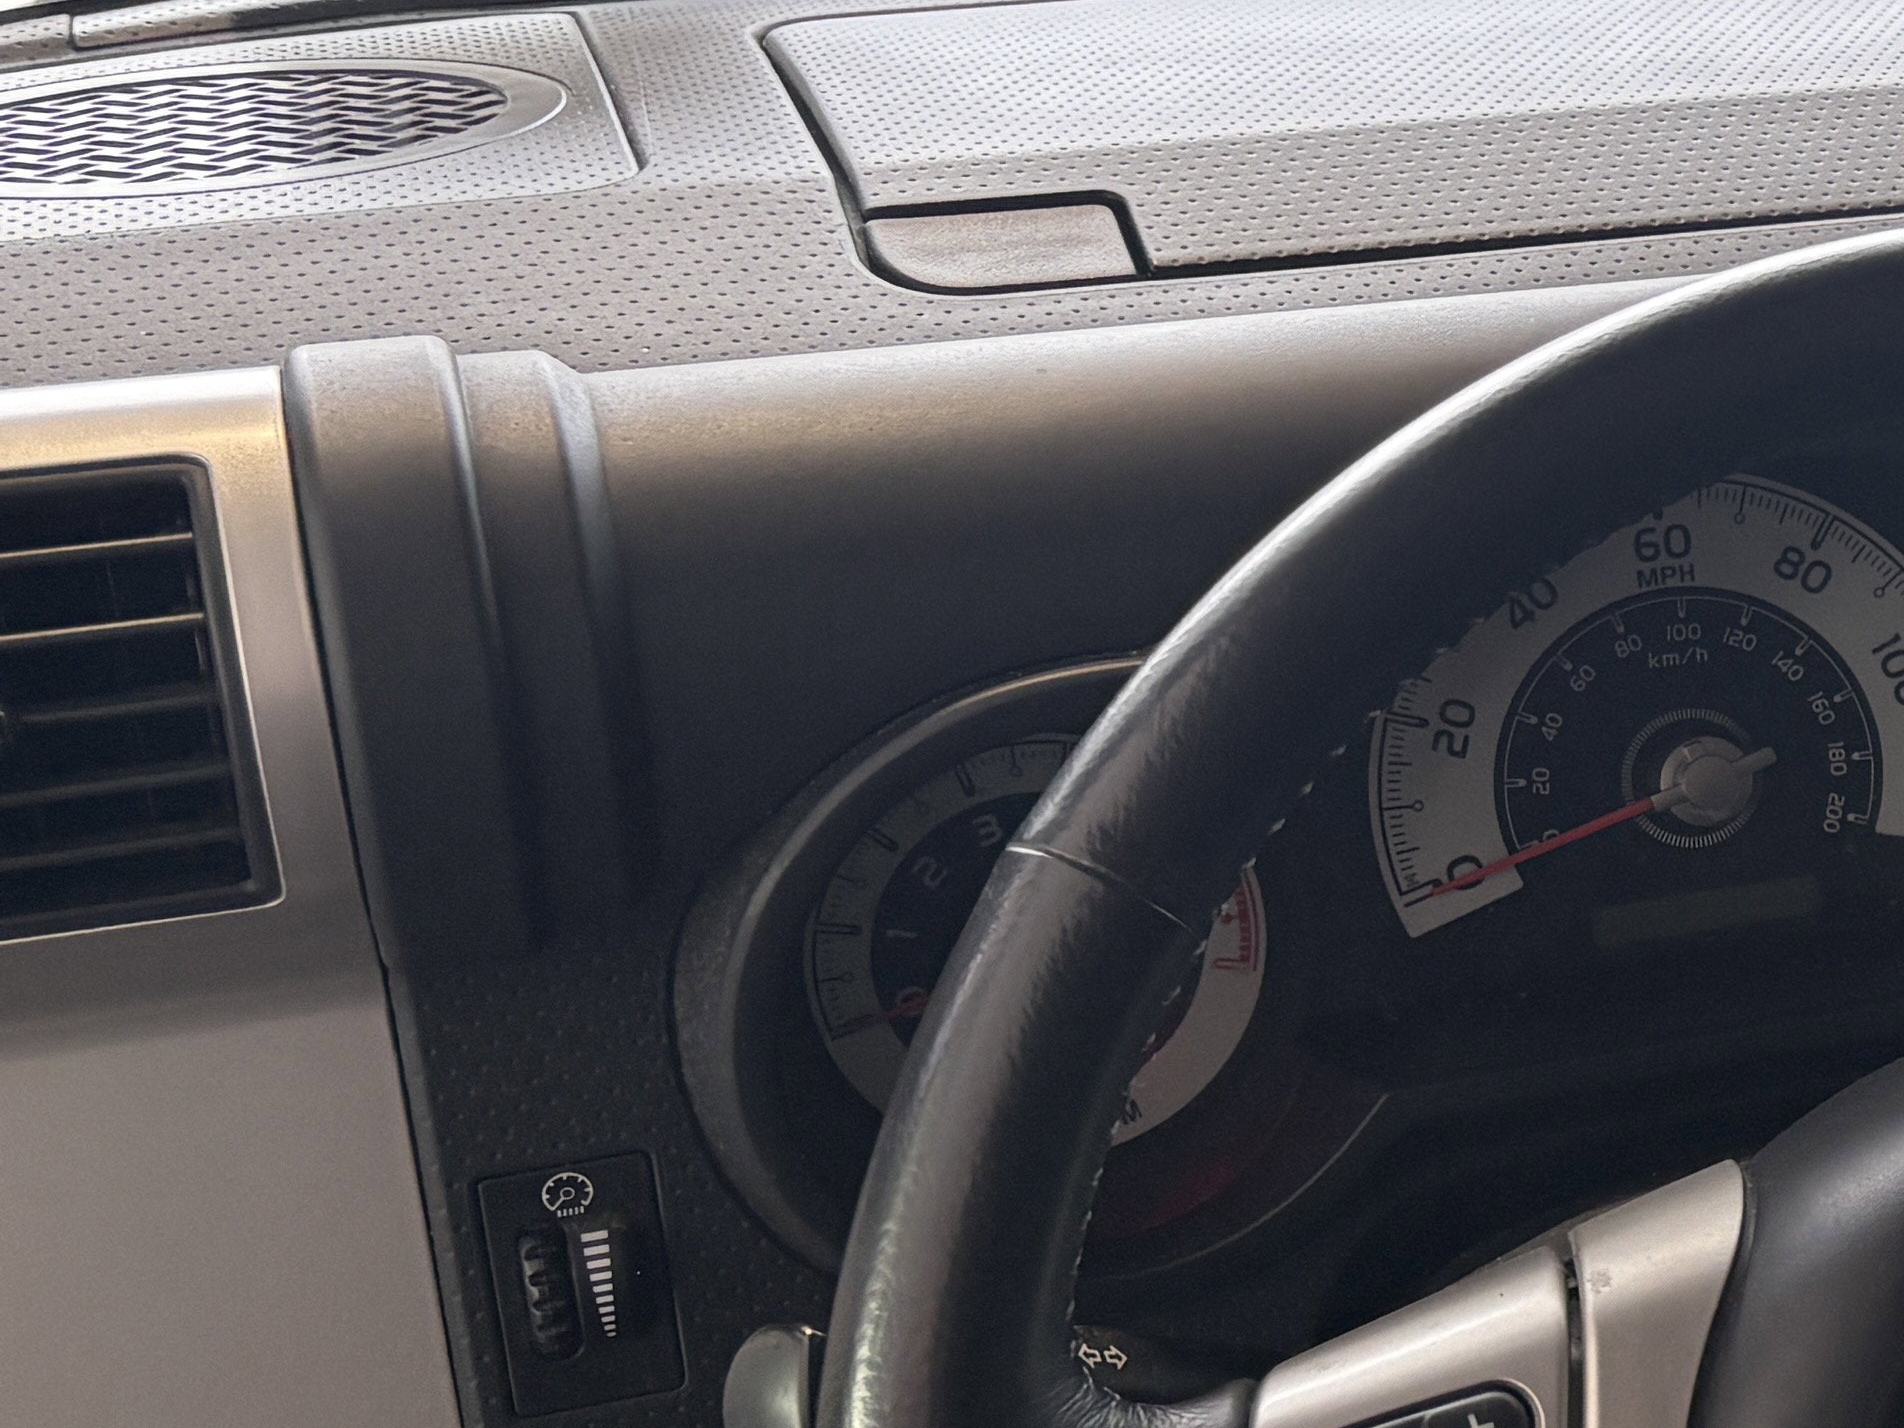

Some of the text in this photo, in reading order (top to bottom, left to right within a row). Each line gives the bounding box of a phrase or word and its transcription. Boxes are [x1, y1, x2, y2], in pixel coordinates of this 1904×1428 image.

[1633, 523, 1691, 563] 60
[1637, 563, 1696, 589] MPH
[1773, 545, 1832, 594] 80
[1507, 576, 1558, 630] 40
[1613, 633, 1642, 658] 80
[1666, 622, 1701, 643] 100
[1722, 625, 1758, 653] 120
[1647, 646, 1709, 670] km/h
[1770, 649, 1804, 682] 140
[1568, 664, 1597, 693] 60
[1807, 690, 1836, 726] 160
[1431, 698, 1476, 760] 20
[1539, 711, 1565, 742] 40
[1826, 740, 1848, 777] 180
[1530, 766, 1551, 796] 20
[1822, 792, 1846, 834] 200
[973, 813, 1002, 848] 3
[912, 855, 949, 891] 2
[885, 928, 918, 940] 1
